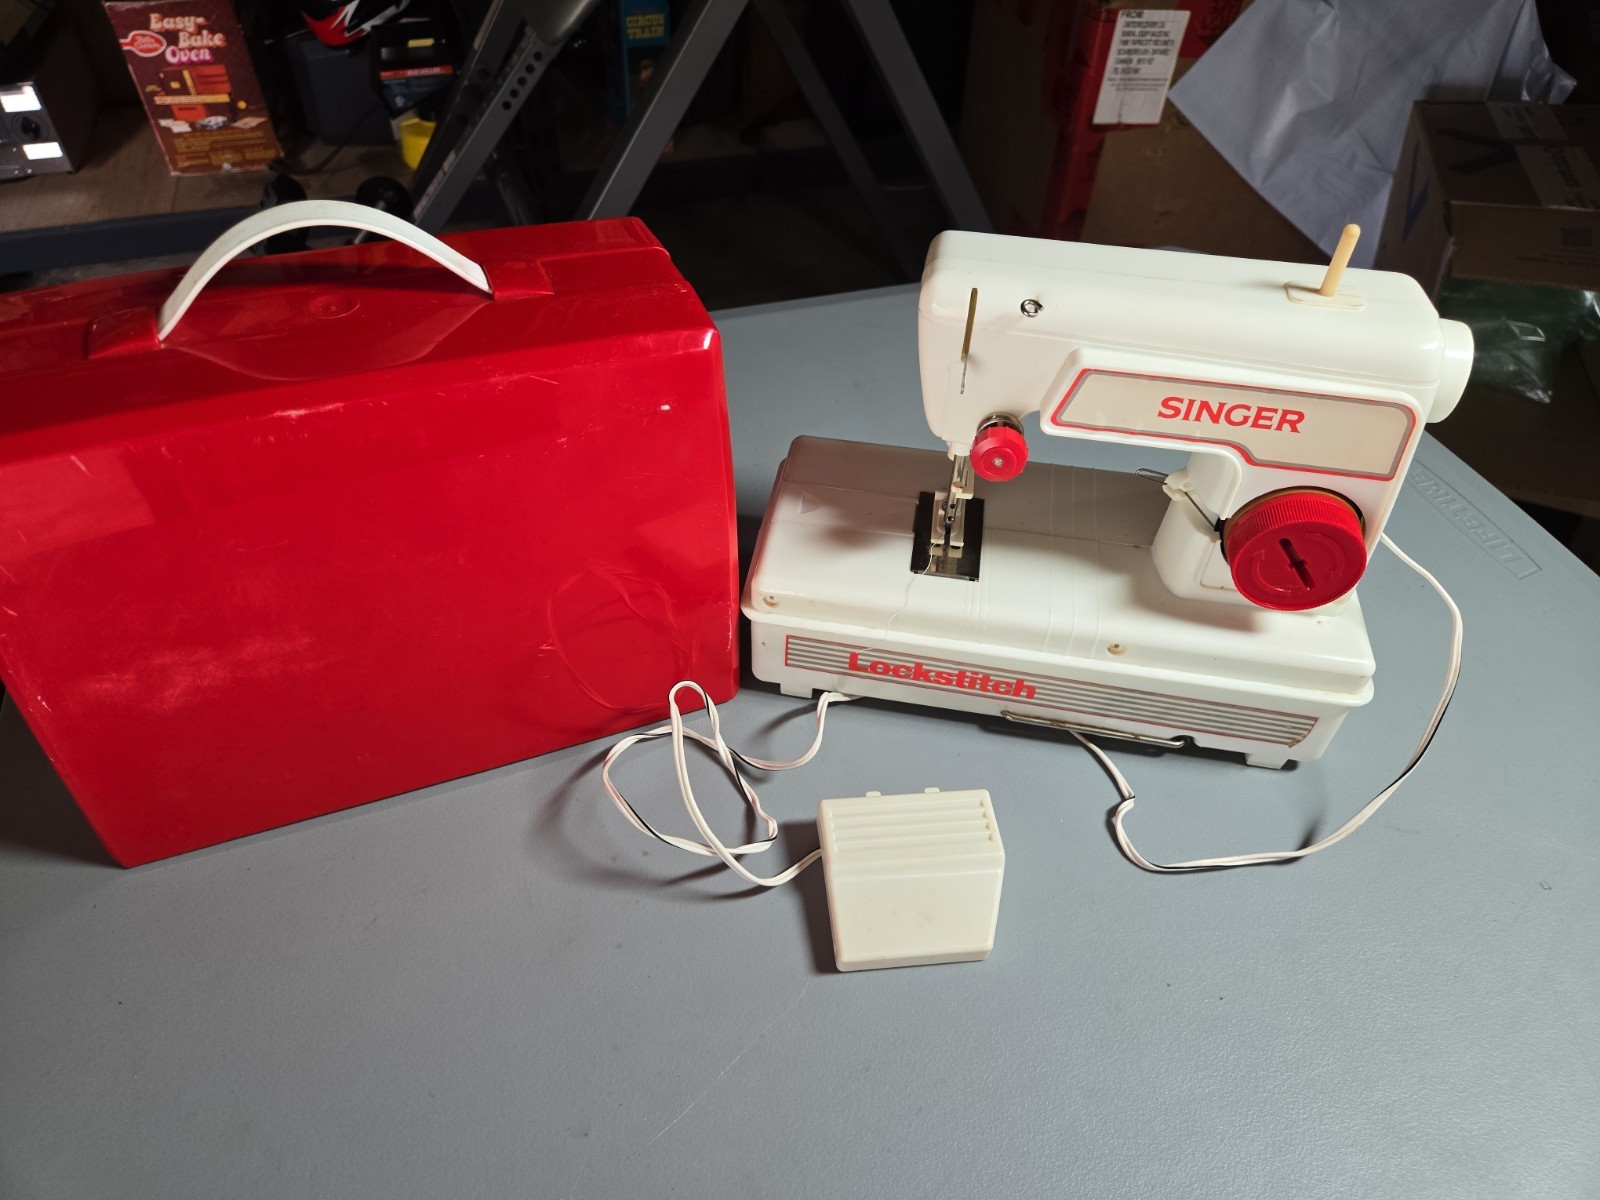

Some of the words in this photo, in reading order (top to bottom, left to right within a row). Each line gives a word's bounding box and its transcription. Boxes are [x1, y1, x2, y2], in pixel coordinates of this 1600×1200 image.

[149, 13, 206, 32] Easy-
[178, 30, 225, 48] Bake
[627, 27, 665, 39] TRAIN
[165, 45, 212, 63] Oven
[1157, 396, 1305, 433] SINGER
[848, 651, 1037, 700] Lockstitch
